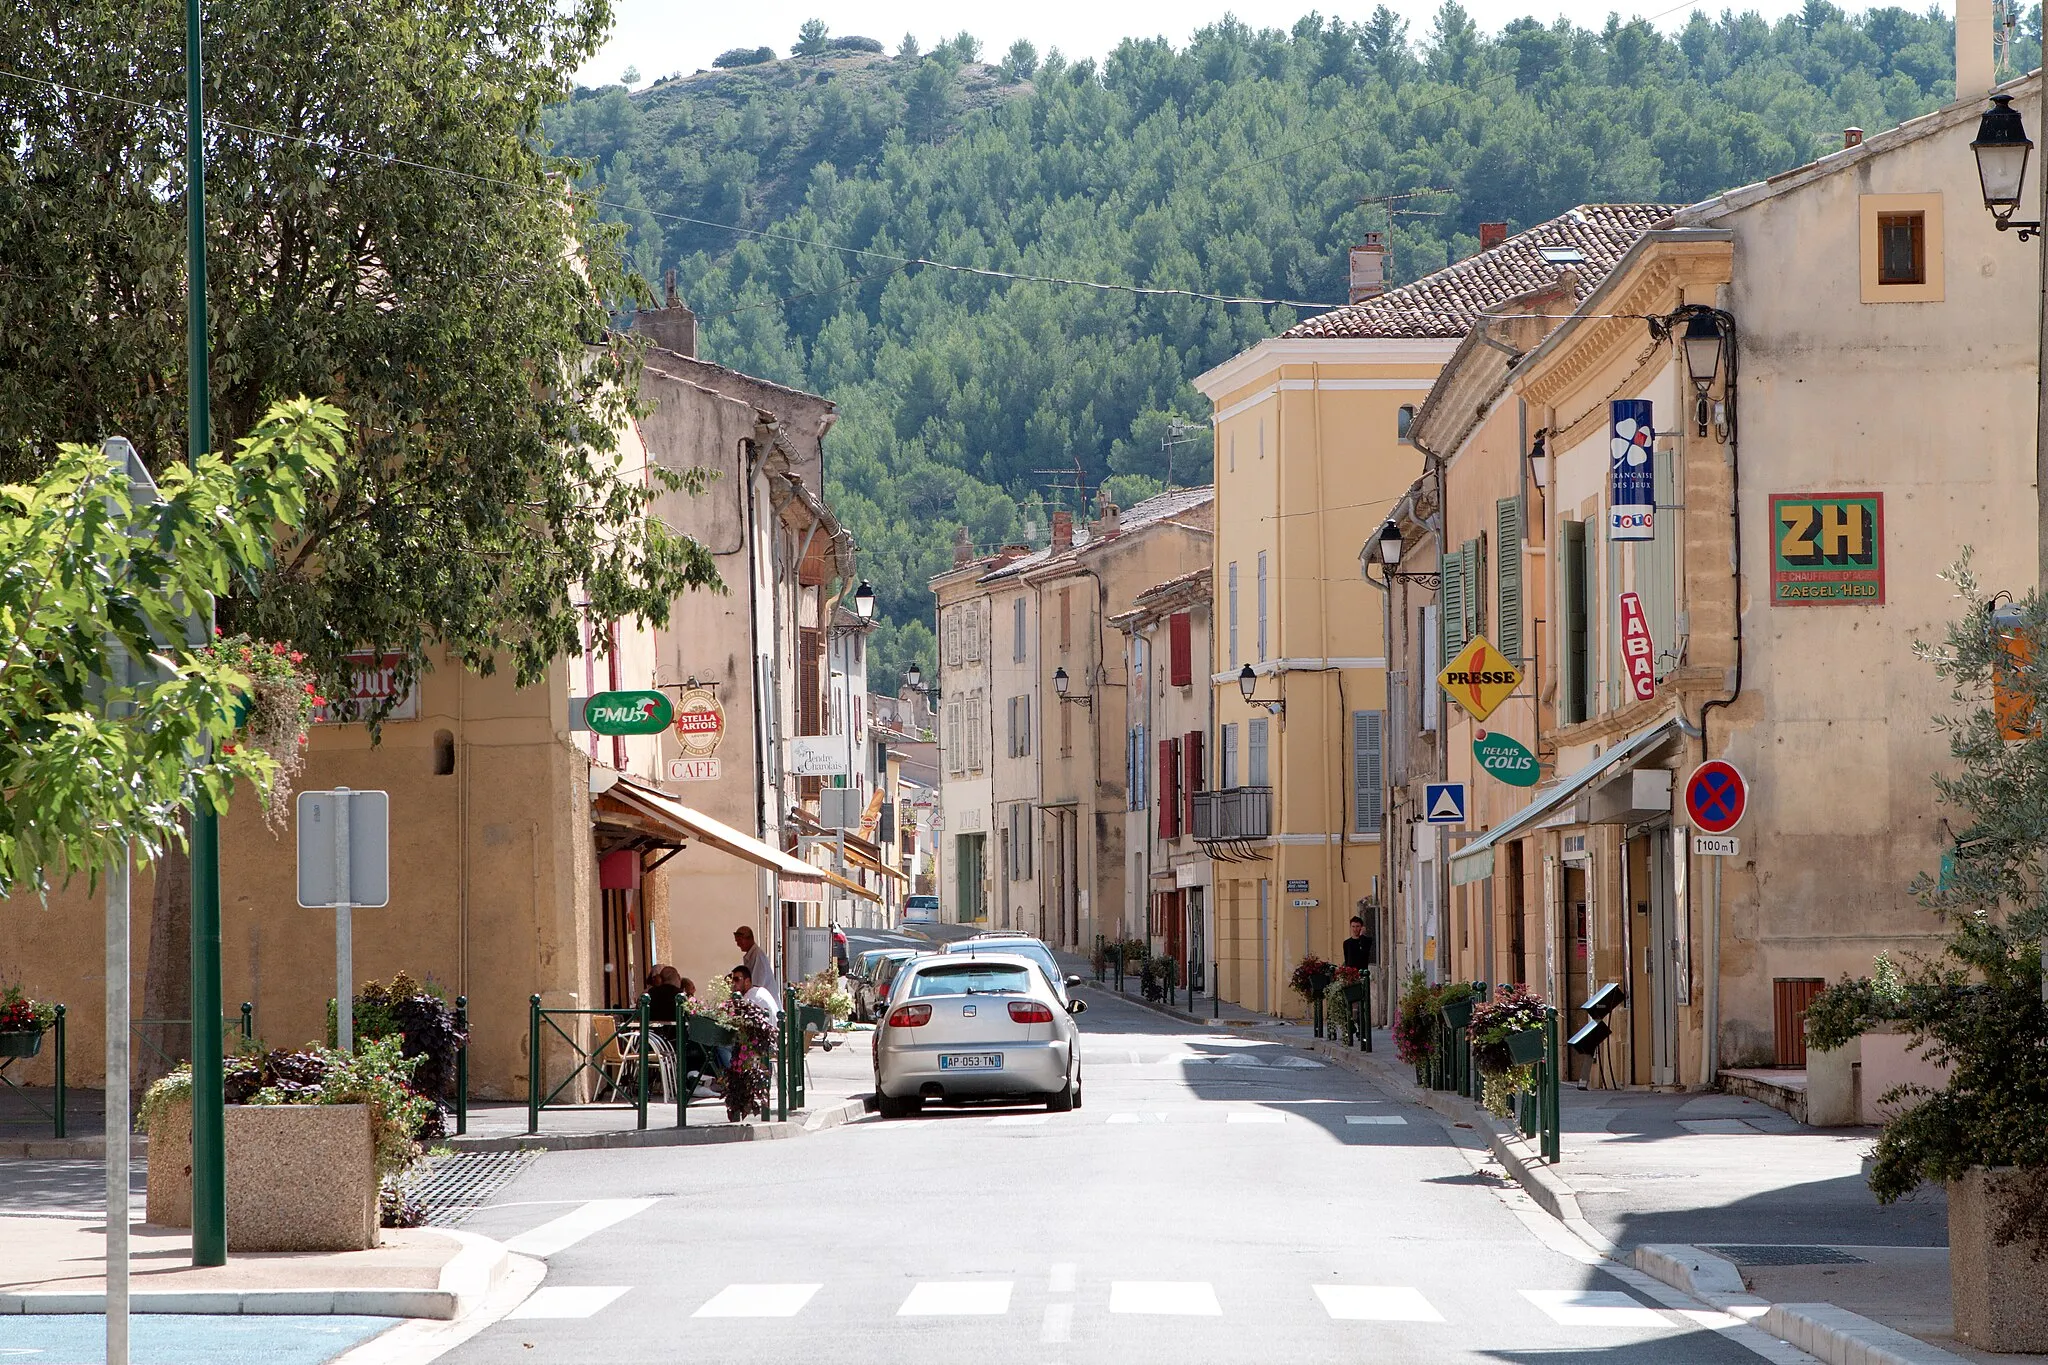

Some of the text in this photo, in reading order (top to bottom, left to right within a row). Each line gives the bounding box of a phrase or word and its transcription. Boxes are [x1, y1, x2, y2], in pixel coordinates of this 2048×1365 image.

[1630, 481, 1651, 489] JEUX
[1612, 513, 1653, 528] LOTO
[1781, 504, 1870, 563] ZH
[1623, 597, 1653, 695] TABAC
[1446, 671, 1515, 685] PRESSE
[593, 707, 635, 722] PMU
[682, 714, 716, 722] STELLA
[682, 722, 717, 730] ARTOIS
[806, 751, 833, 762] Tendre
[1482, 747, 1519, 755] RELAIS
[672, 762, 717, 778] CAFE
[804, 760, 842, 771] Charolais
[1484, 756, 1532, 770] COLIS
